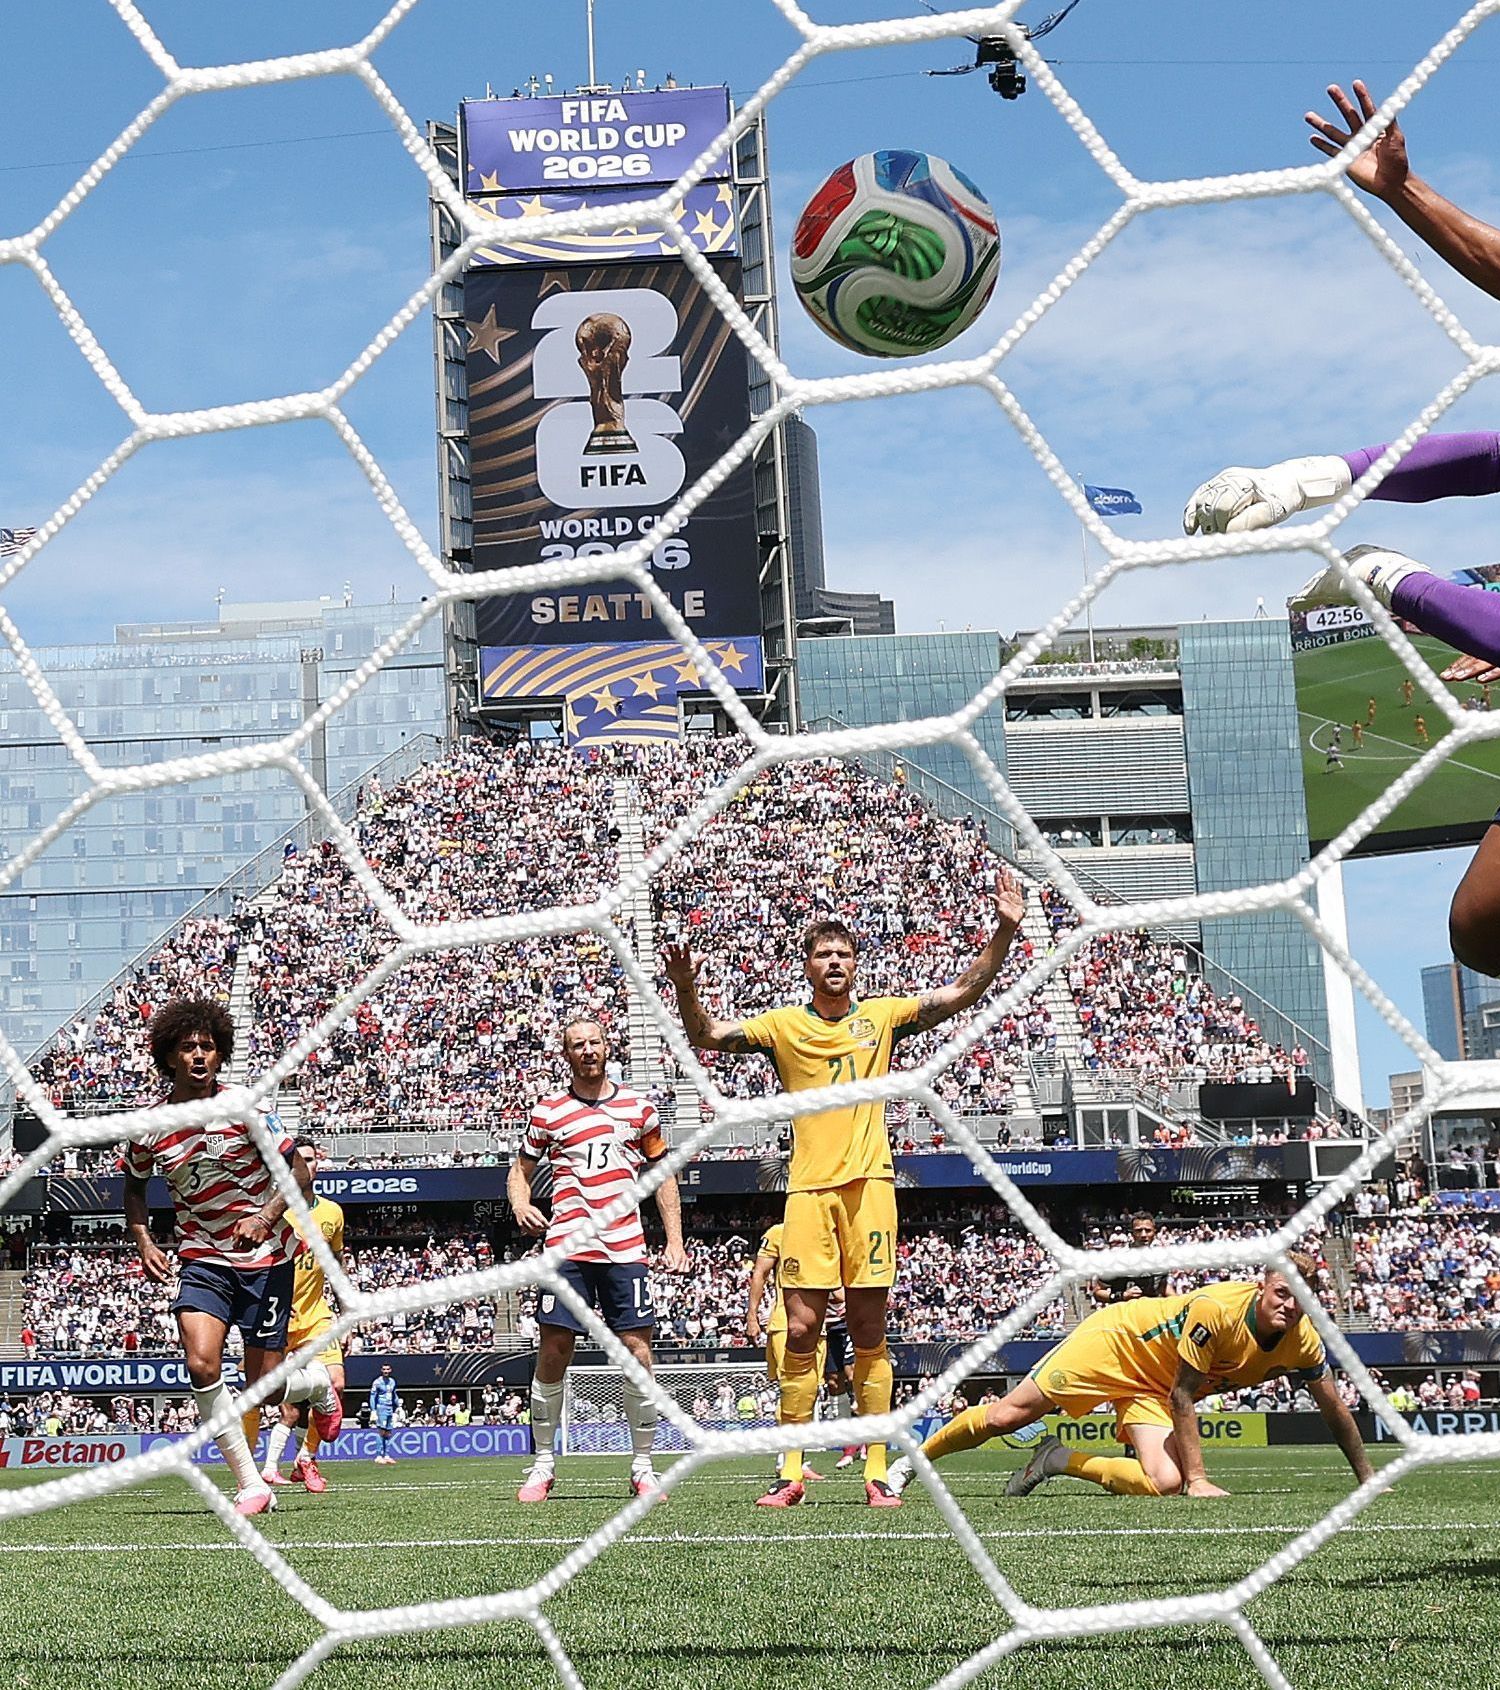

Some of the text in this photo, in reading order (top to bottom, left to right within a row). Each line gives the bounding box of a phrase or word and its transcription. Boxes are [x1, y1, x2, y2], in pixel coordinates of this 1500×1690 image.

[561, 98, 628, 124] FIFA
[508, 123, 686, 152] WORLD CUP
[543, 154, 651, 180] 2026
[580, 464, 646, 488] FIFA
[539, 515, 689, 539] WORLD CP
[531, 590, 706, 625] SEATTE
[1316, 607, 1364, 627] 42:56
[1343, 626, 1377, 641] BONV
[587, 1142, 611, 1170] 13
[188, 1162, 200, 1190] 3
[312, 1177, 418, 1195] CUP 2026
[869, 1230, 893, 1265] 21
[633, 1277, 652, 1308] 13
[263, 1296, 279, 1328] 3
[2, 1363, 193, 1388] FIFA WORLD CU
[1199, 1415, 1242, 1440] bre
[21, 1439, 126, 1465] Betano
